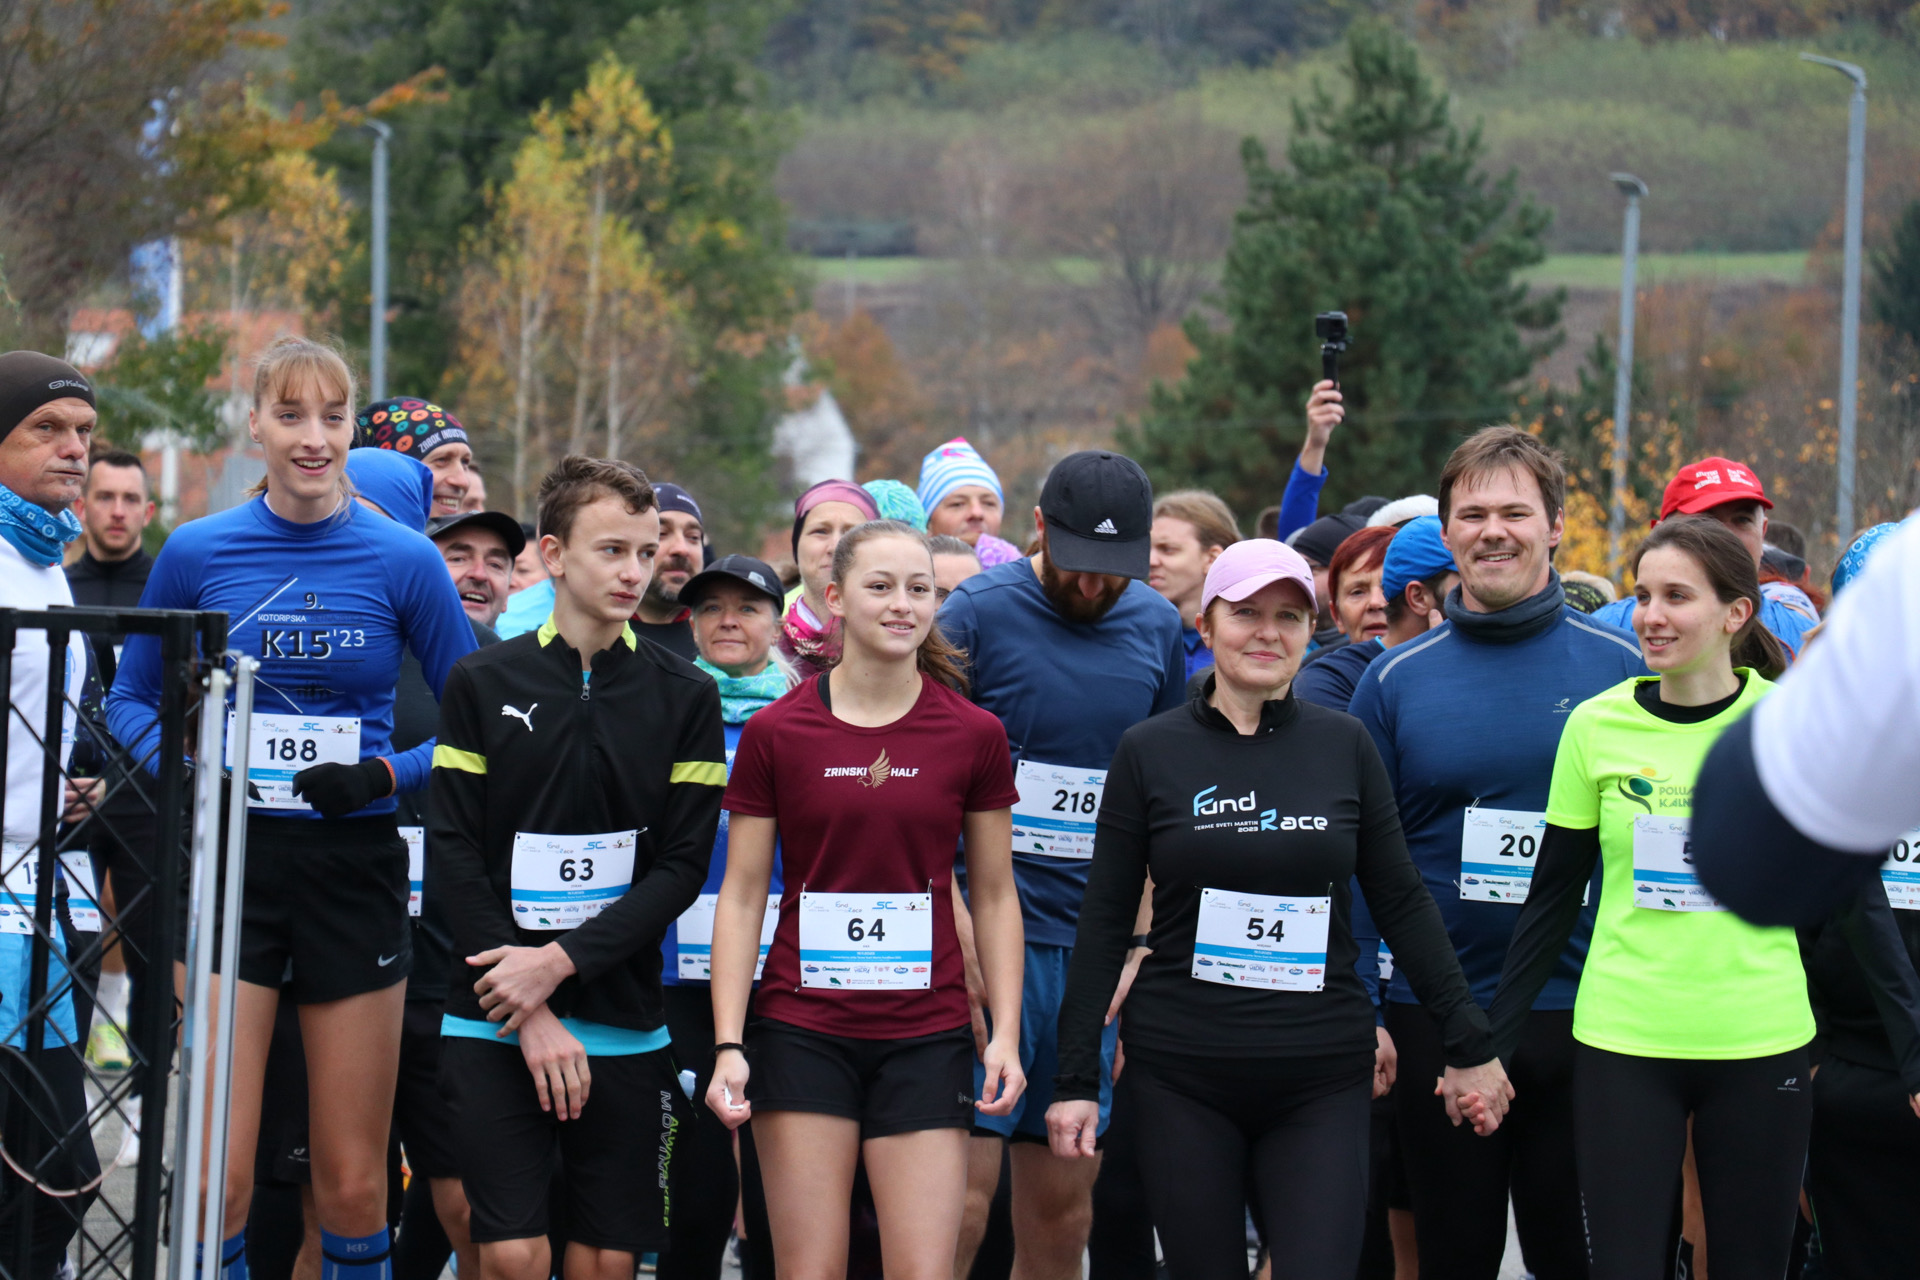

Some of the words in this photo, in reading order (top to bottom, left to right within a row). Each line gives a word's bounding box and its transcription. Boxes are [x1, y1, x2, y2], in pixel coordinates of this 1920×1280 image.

[417, 432, 442, 453] ZABOK
[303, 591, 324, 610] 9.
[257, 613, 307, 623] KOTORIPSKA
[266, 737, 318, 763] 188
[823, 767, 868, 777] ZRINSKI
[890, 767, 919, 777] HALF
[1052, 789, 1097, 815] 218
[1193, 784, 1257, 817] Fund
[1194, 823, 1215, 831] TERME
[1259, 808, 1329, 831] Race
[1499, 833, 1536, 858] 20
[559, 858, 595, 882] 63
[847, 917, 886, 942] 64
[1246, 917, 1285, 943] 54
[663, 1185, 671, 1228] KEEP
